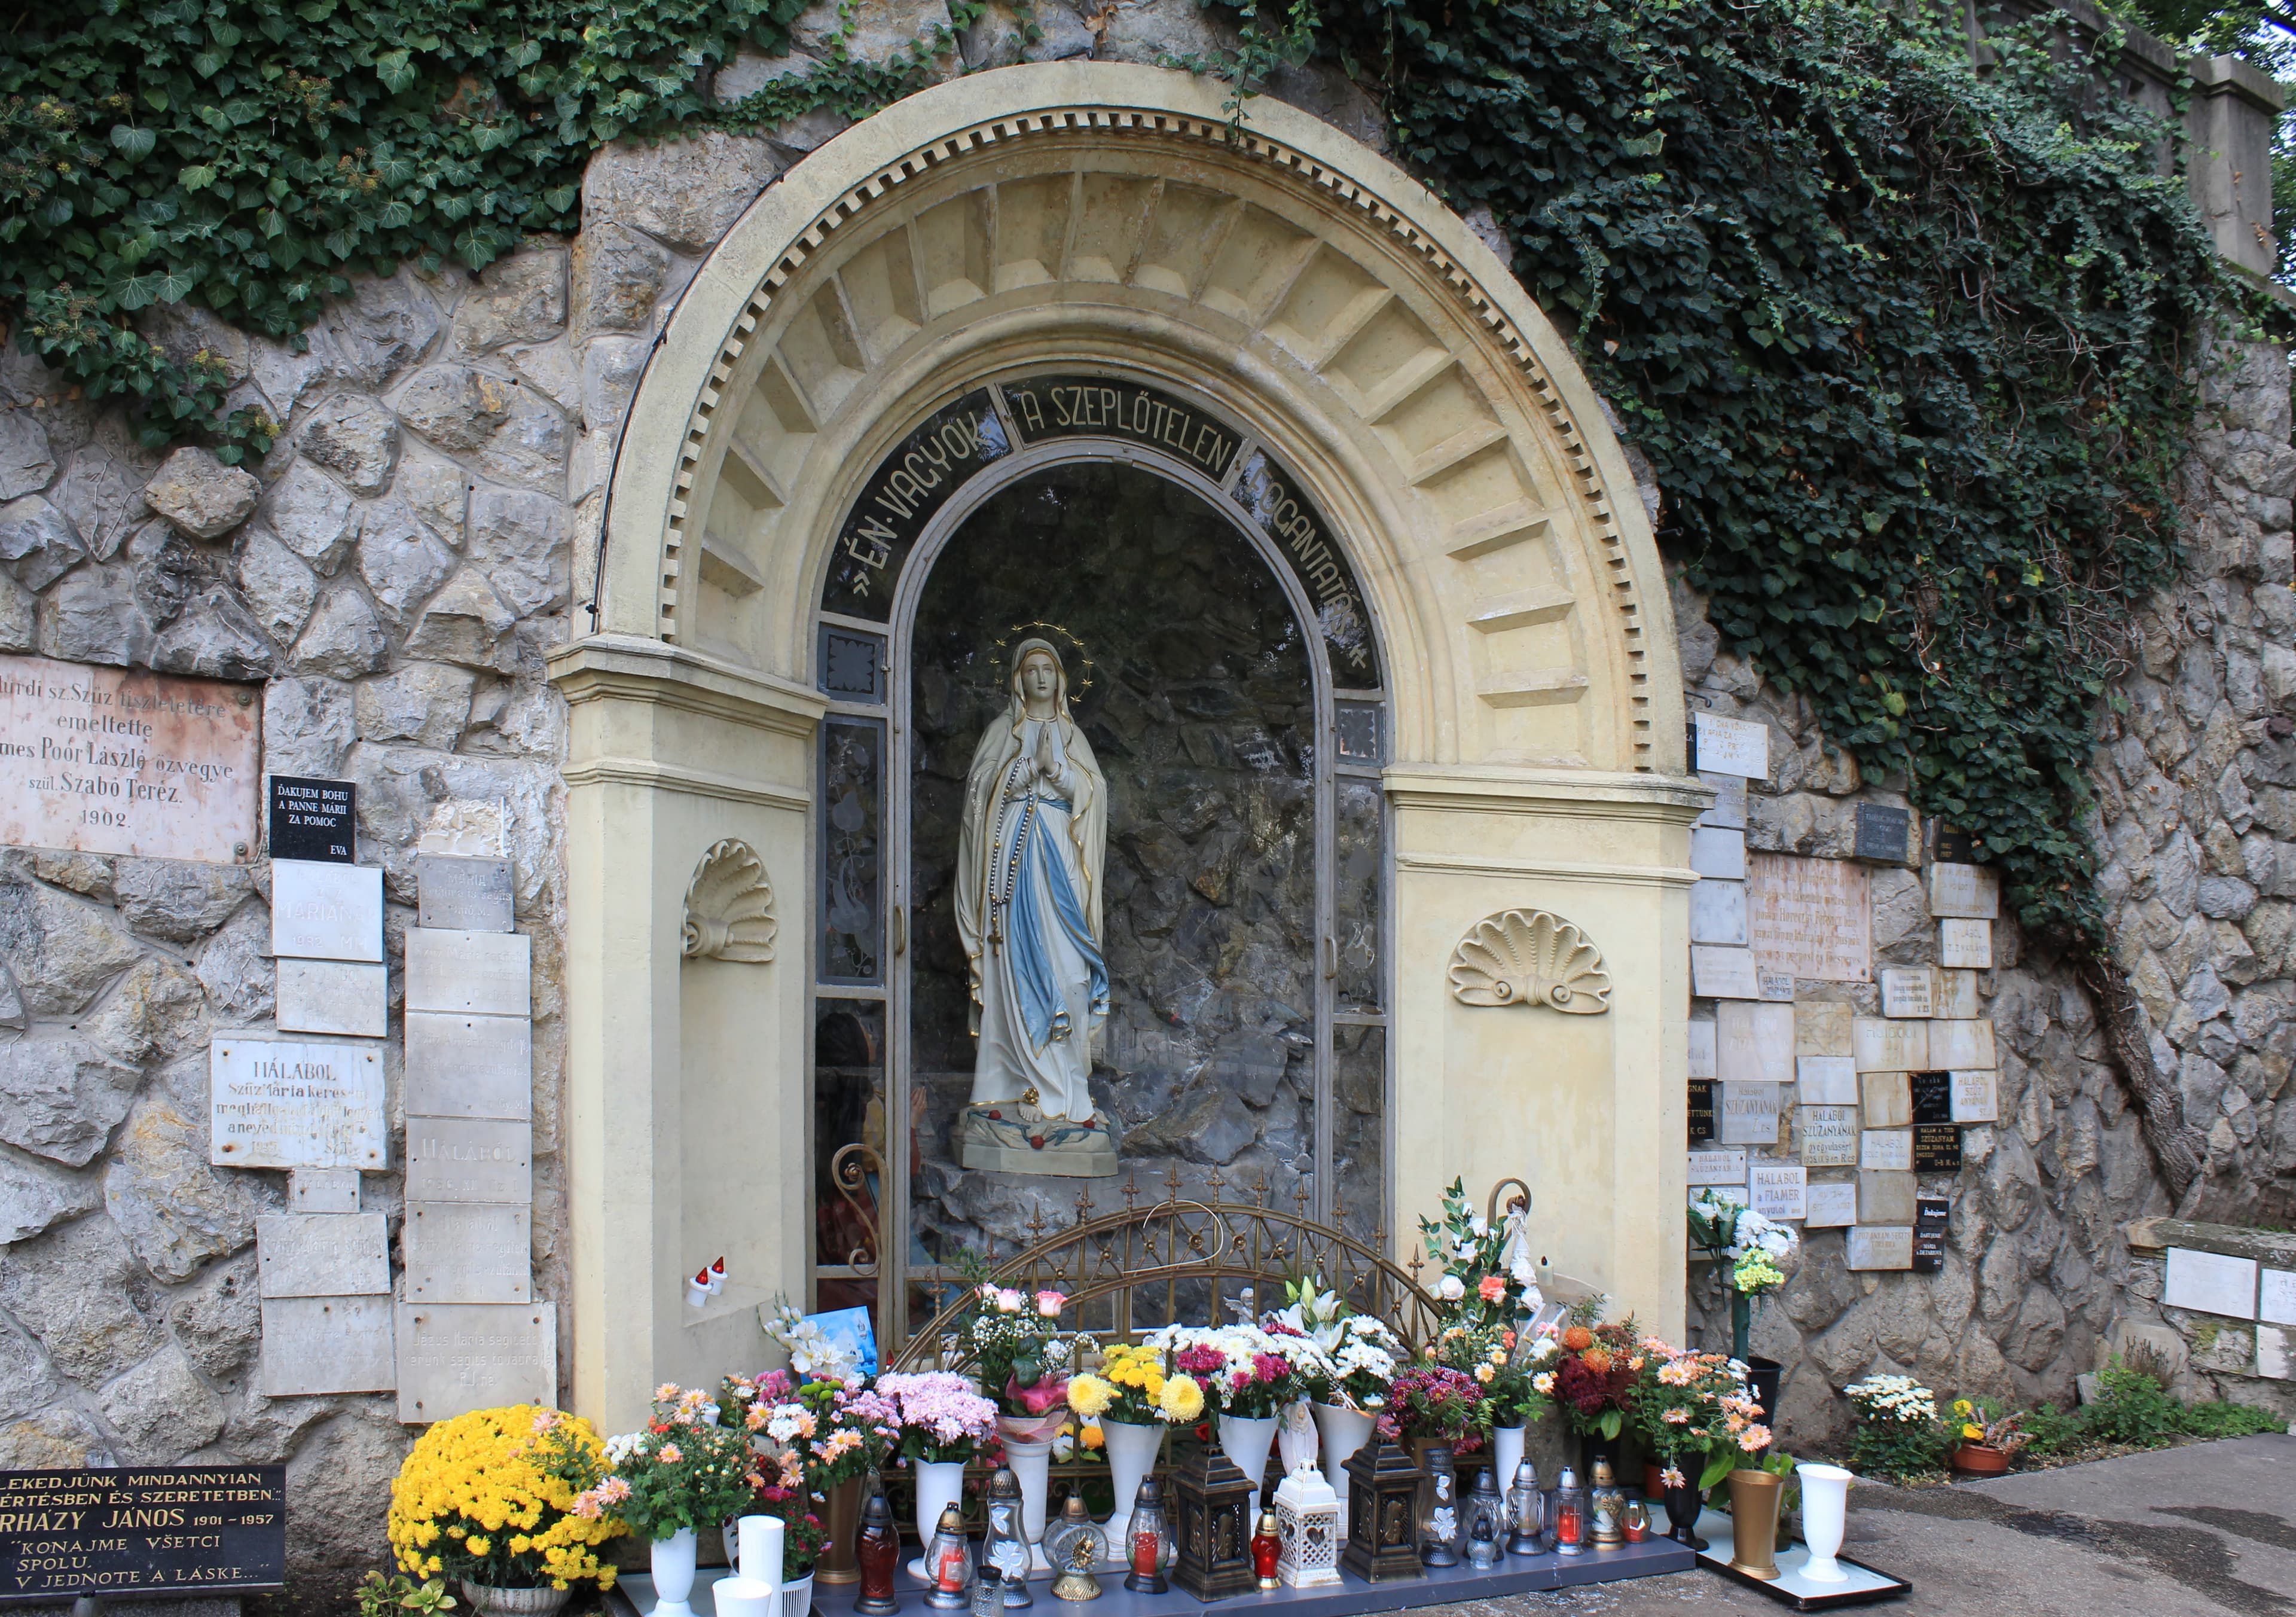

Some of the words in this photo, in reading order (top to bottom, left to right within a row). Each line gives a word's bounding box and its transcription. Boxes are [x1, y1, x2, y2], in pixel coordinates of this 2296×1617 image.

[1021, 390, 1045, 431] A
[1051, 385, 1232, 473] SZEPLŐTELEN
[57, 715, 152, 737] emeltette
[155, 753, 234, 783] özvegye
[61, 771, 120, 797] Szabó
[126, 778, 183, 804] Teréz.
[277, 783, 319, 799] ĎAKUJEM
[322, 789, 349, 801] BOHU
[279, 800, 285, 810] A
[289, 800, 318, 812] PANNE
[322, 801, 347, 814] MÁRII
[81, 809, 132, 828] 1902.
[289, 814, 301, 824] ZA
[304, 815, 337, 827] POMOC
[330, 845, 347, 855] EVA
[128, 1473, 261, 1487] MINDANNYIAN
[108, 1490, 133, 1504] ÉS
[102, 1505, 185, 1528] JÁNOS
[194, 1516, 222, 1526] 1901
[241, 1514, 274, 1525] 1957
[145, 1534, 221, 1550] VŠETCI
[14, 1576, 32, 1589] V
[40, 1570, 141, 1588] JEDNOTE
[149, 1569, 165, 1583] A
